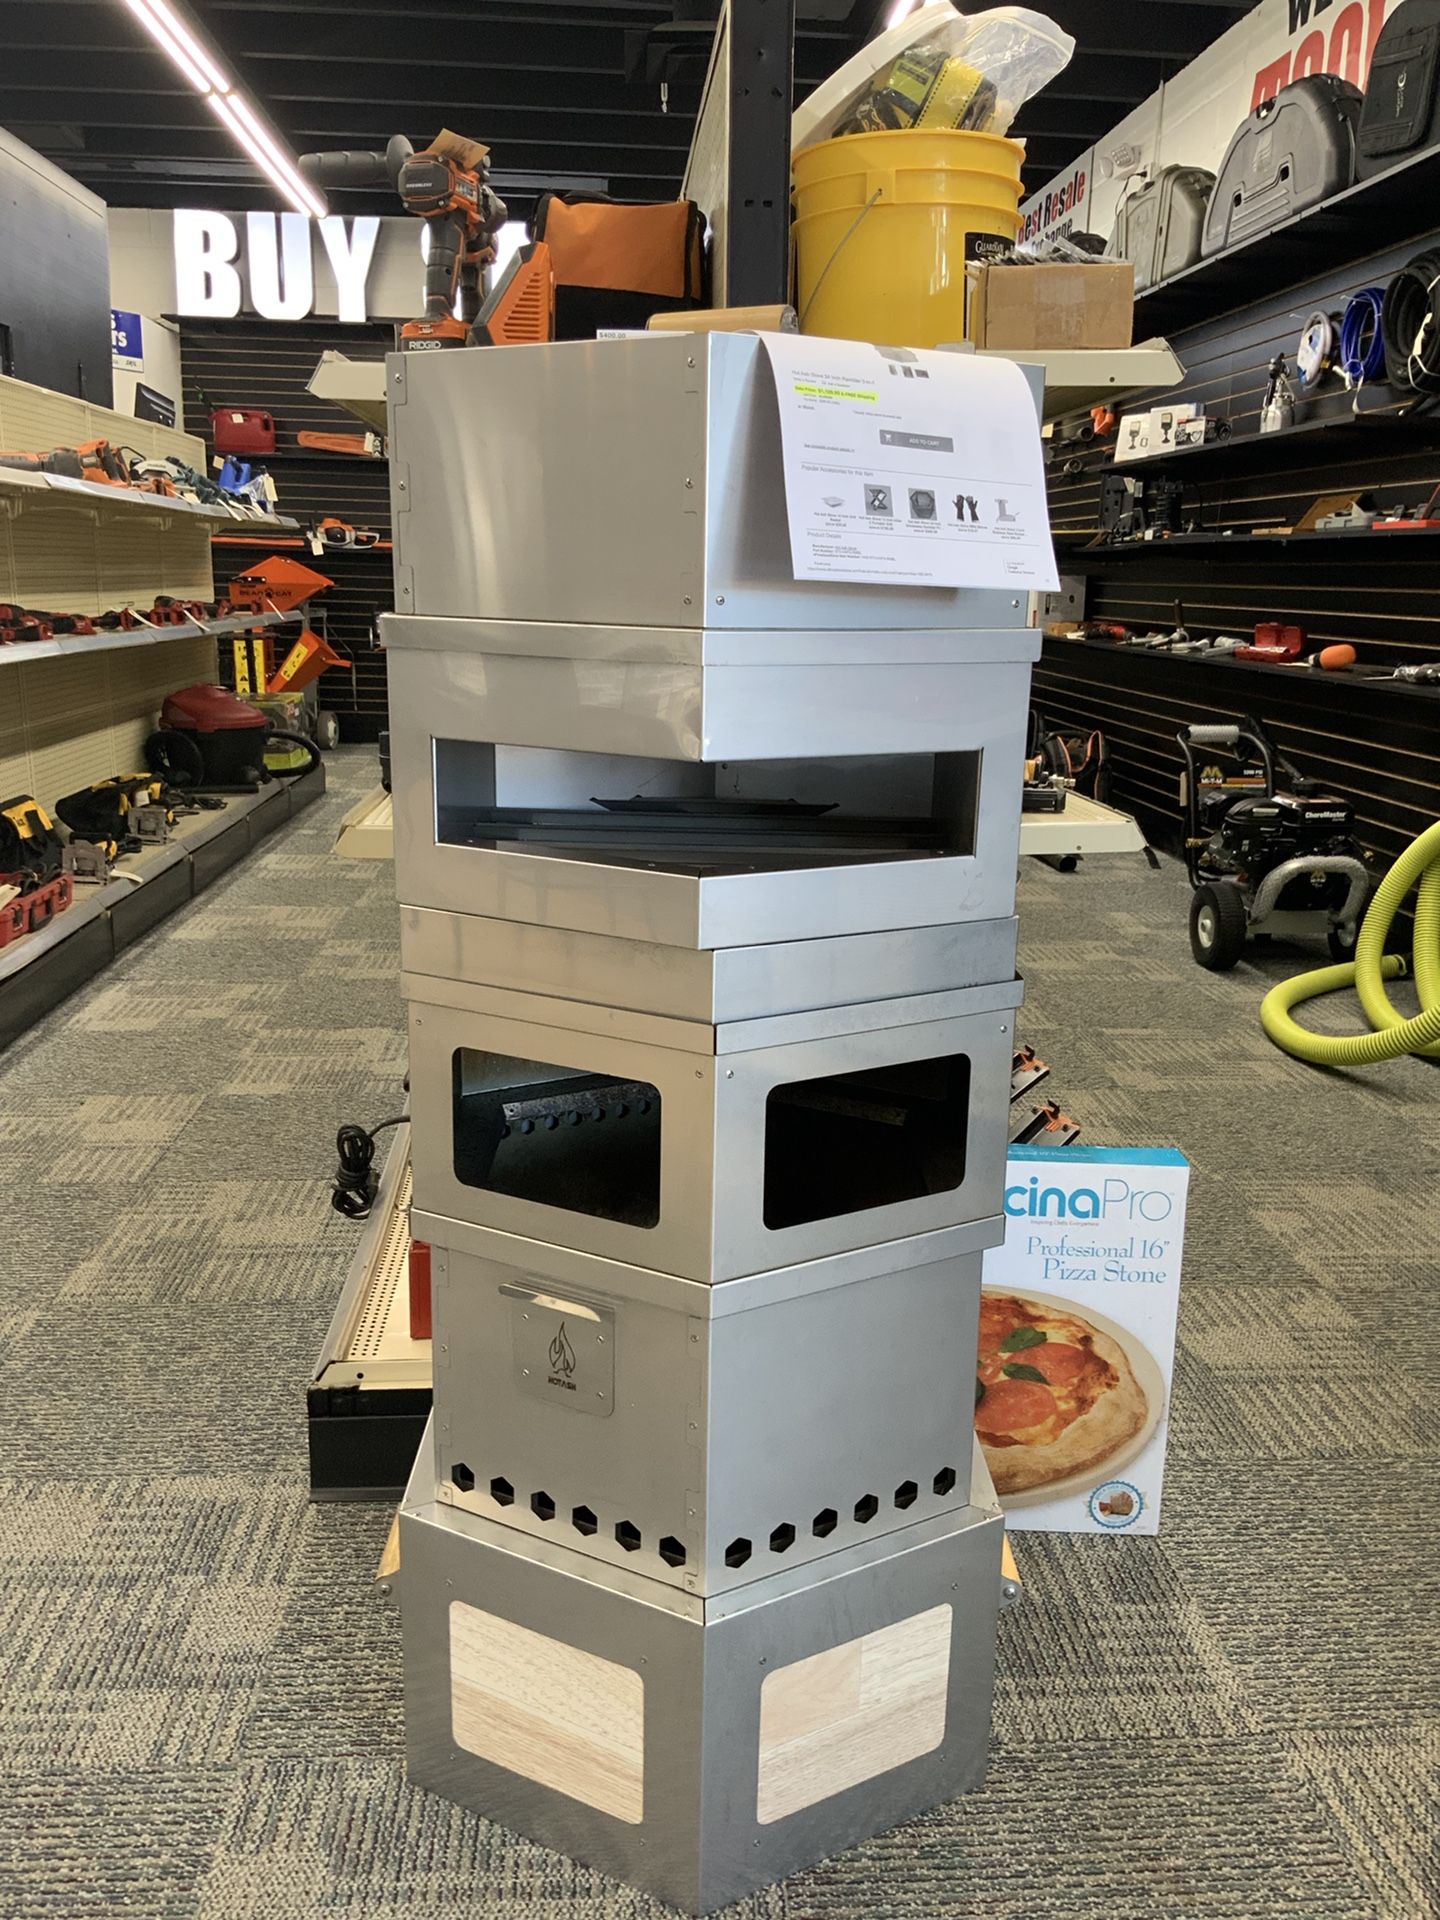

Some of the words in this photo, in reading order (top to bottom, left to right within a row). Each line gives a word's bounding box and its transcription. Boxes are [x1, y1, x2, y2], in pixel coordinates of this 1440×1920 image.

[1044, 170, 1085, 228] Resale
[174, 208, 381, 323] BUY
[409, 341, 441, 350] RIDGID
[1305, 811, 1347, 819] ChoreMaster
[1027, 1235, 1134, 1259] Professional
[1042, 1258, 1097, 1281] Pizza
[1104, 1260, 1167, 1283] Stone
